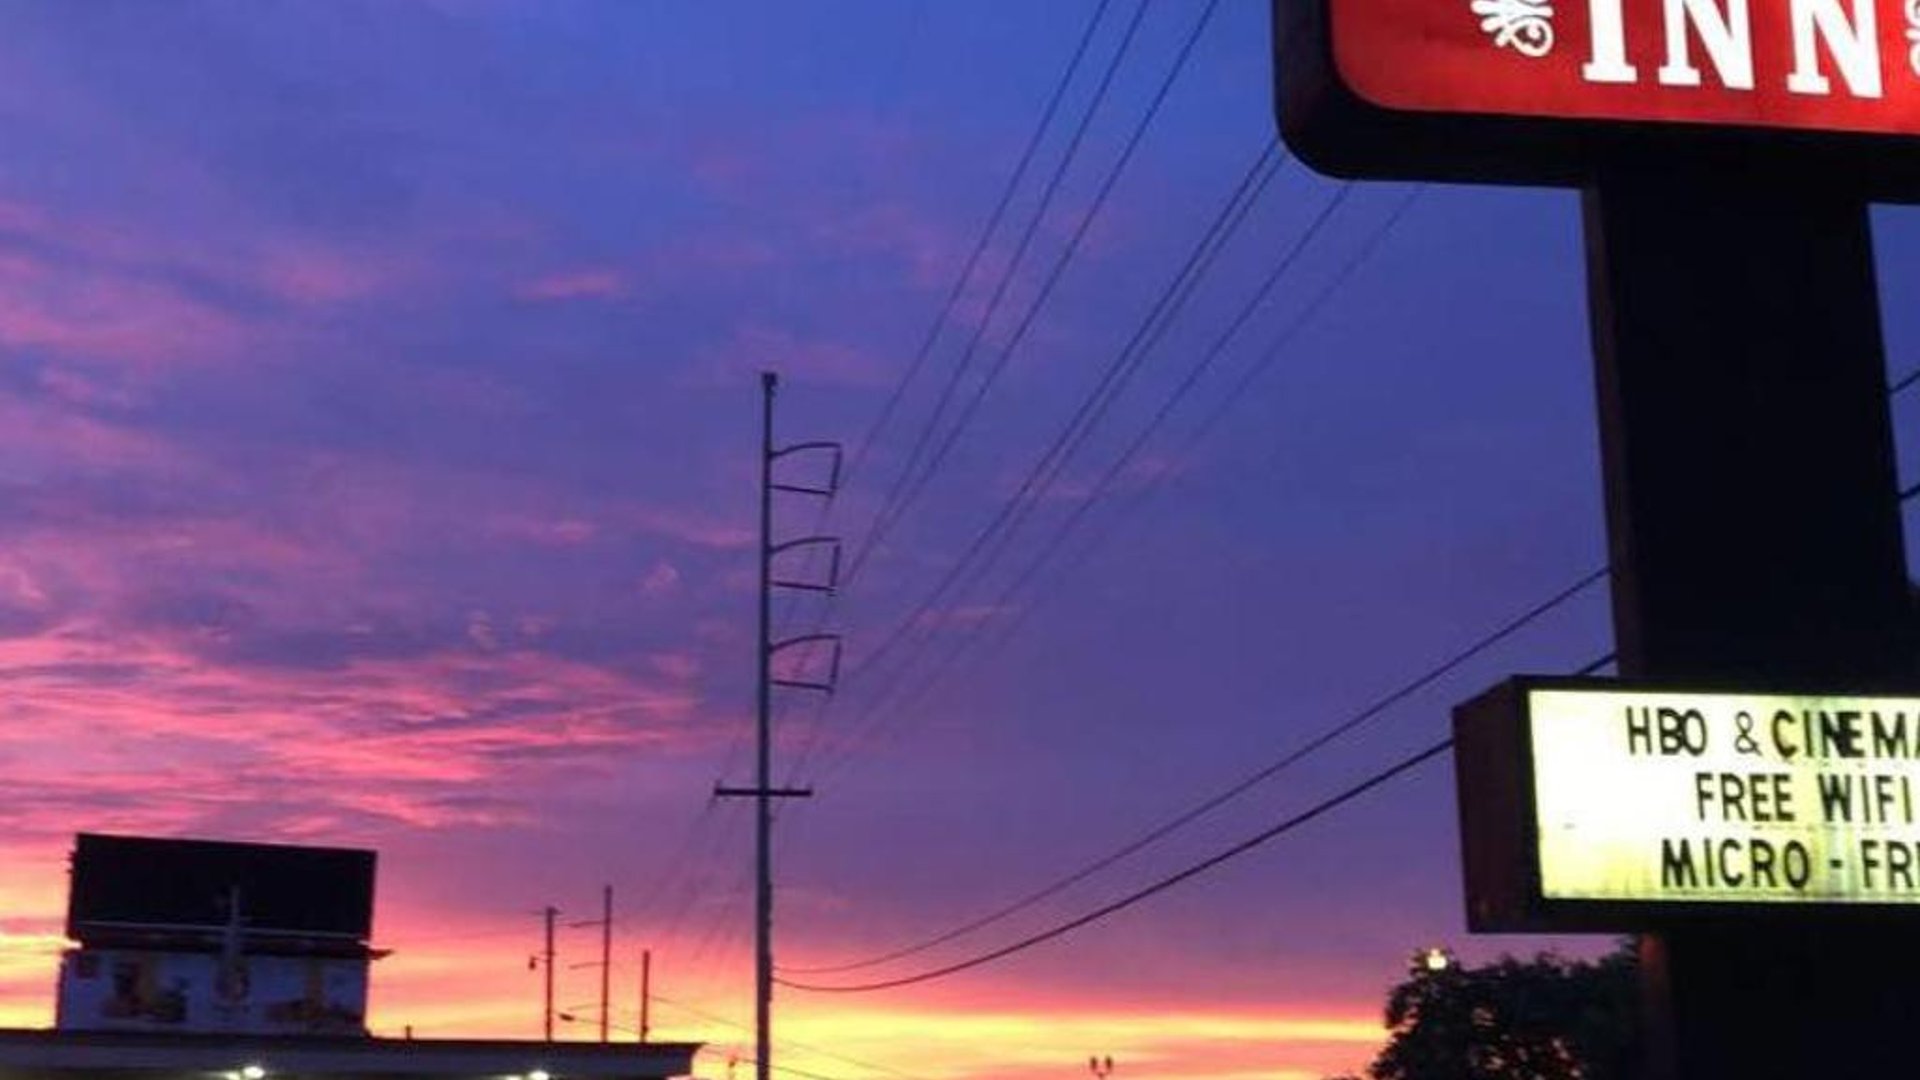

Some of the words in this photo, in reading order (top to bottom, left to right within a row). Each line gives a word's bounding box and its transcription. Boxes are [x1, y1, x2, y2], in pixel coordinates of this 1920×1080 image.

[1582, 0, 1884, 98] INN
[1626, 706, 1708, 755] HBO
[1734, 711, 1763, 757] &
[1771, 710, 1920, 759] CINEM
[1695, 772, 1796, 823] FREE
[1817, 774, 1913, 824] WIFI
[1661, 838, 1811, 889] MICRO
[1861, 839, 1920, 889] FR
